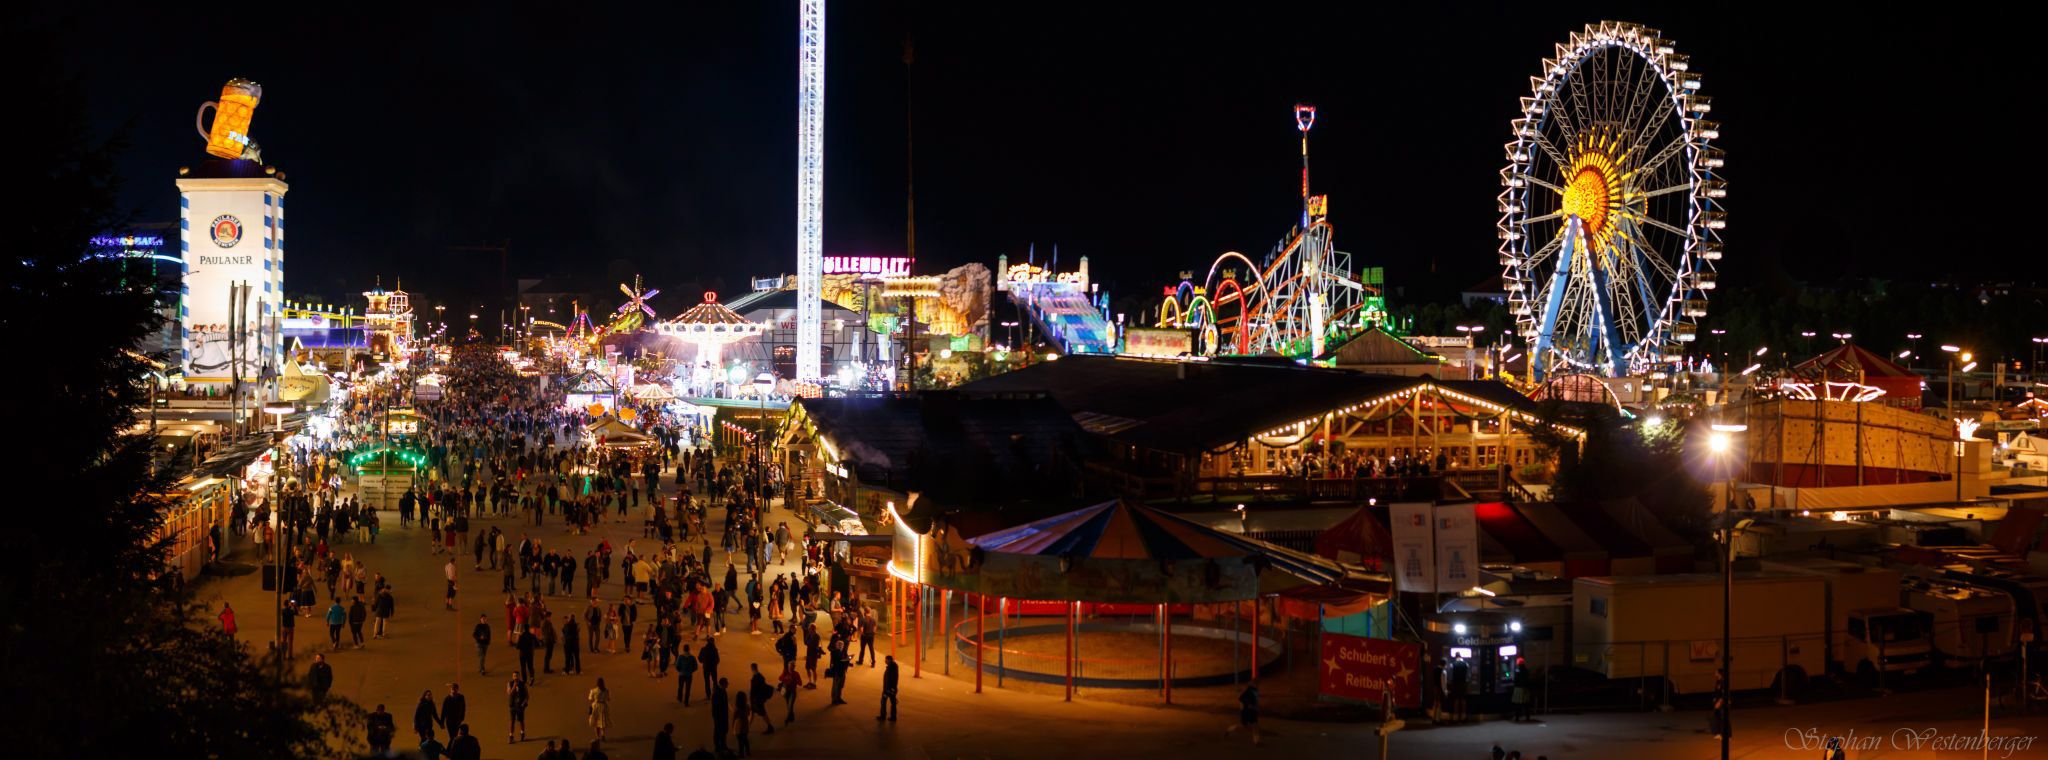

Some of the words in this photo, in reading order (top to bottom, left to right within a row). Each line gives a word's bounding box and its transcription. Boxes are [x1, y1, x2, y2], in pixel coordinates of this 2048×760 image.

[200, 255, 252, 265] PAULANER
[1457, 636, 1514, 646] Geldautomat
[1693, 641, 1714, 656] WC
